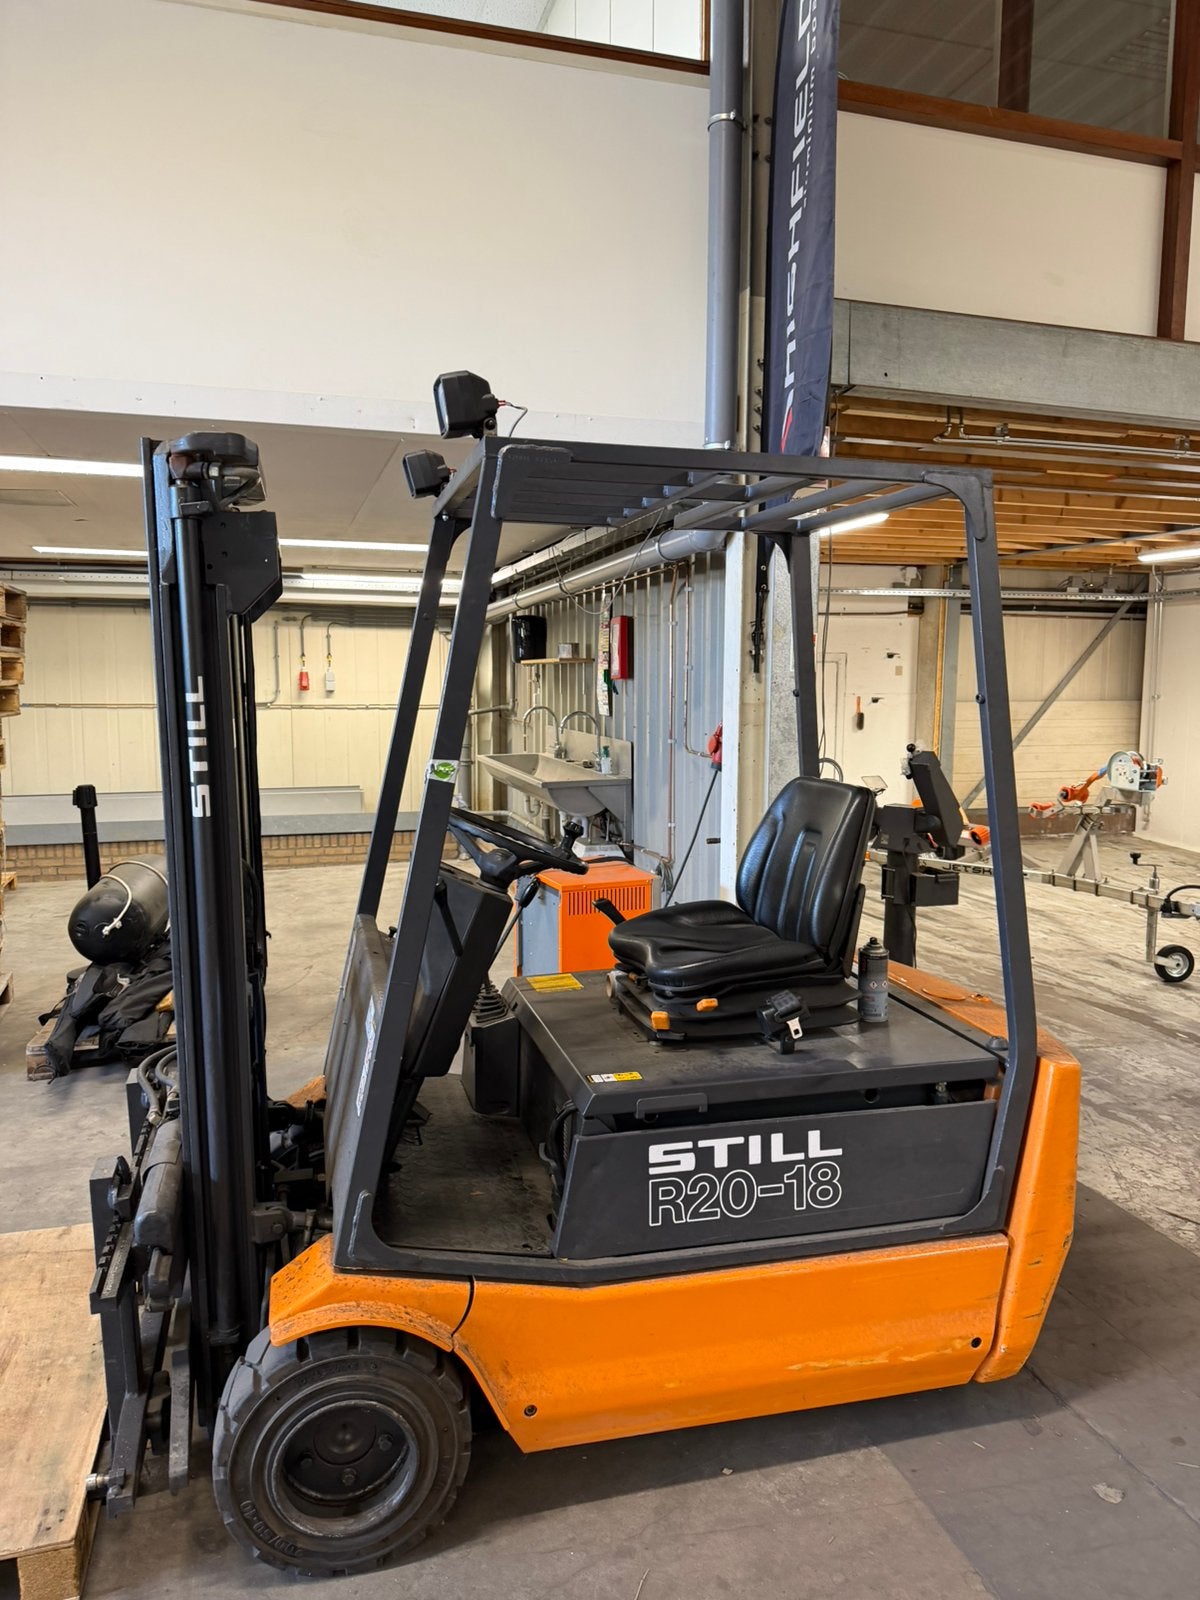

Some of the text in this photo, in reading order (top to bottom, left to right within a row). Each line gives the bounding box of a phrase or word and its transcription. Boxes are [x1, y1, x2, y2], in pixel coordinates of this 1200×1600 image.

[185, 676, 211, 817] STILL
[649, 1130, 843, 1175] STILL
[649, 1161, 842, 1226] R20-18
